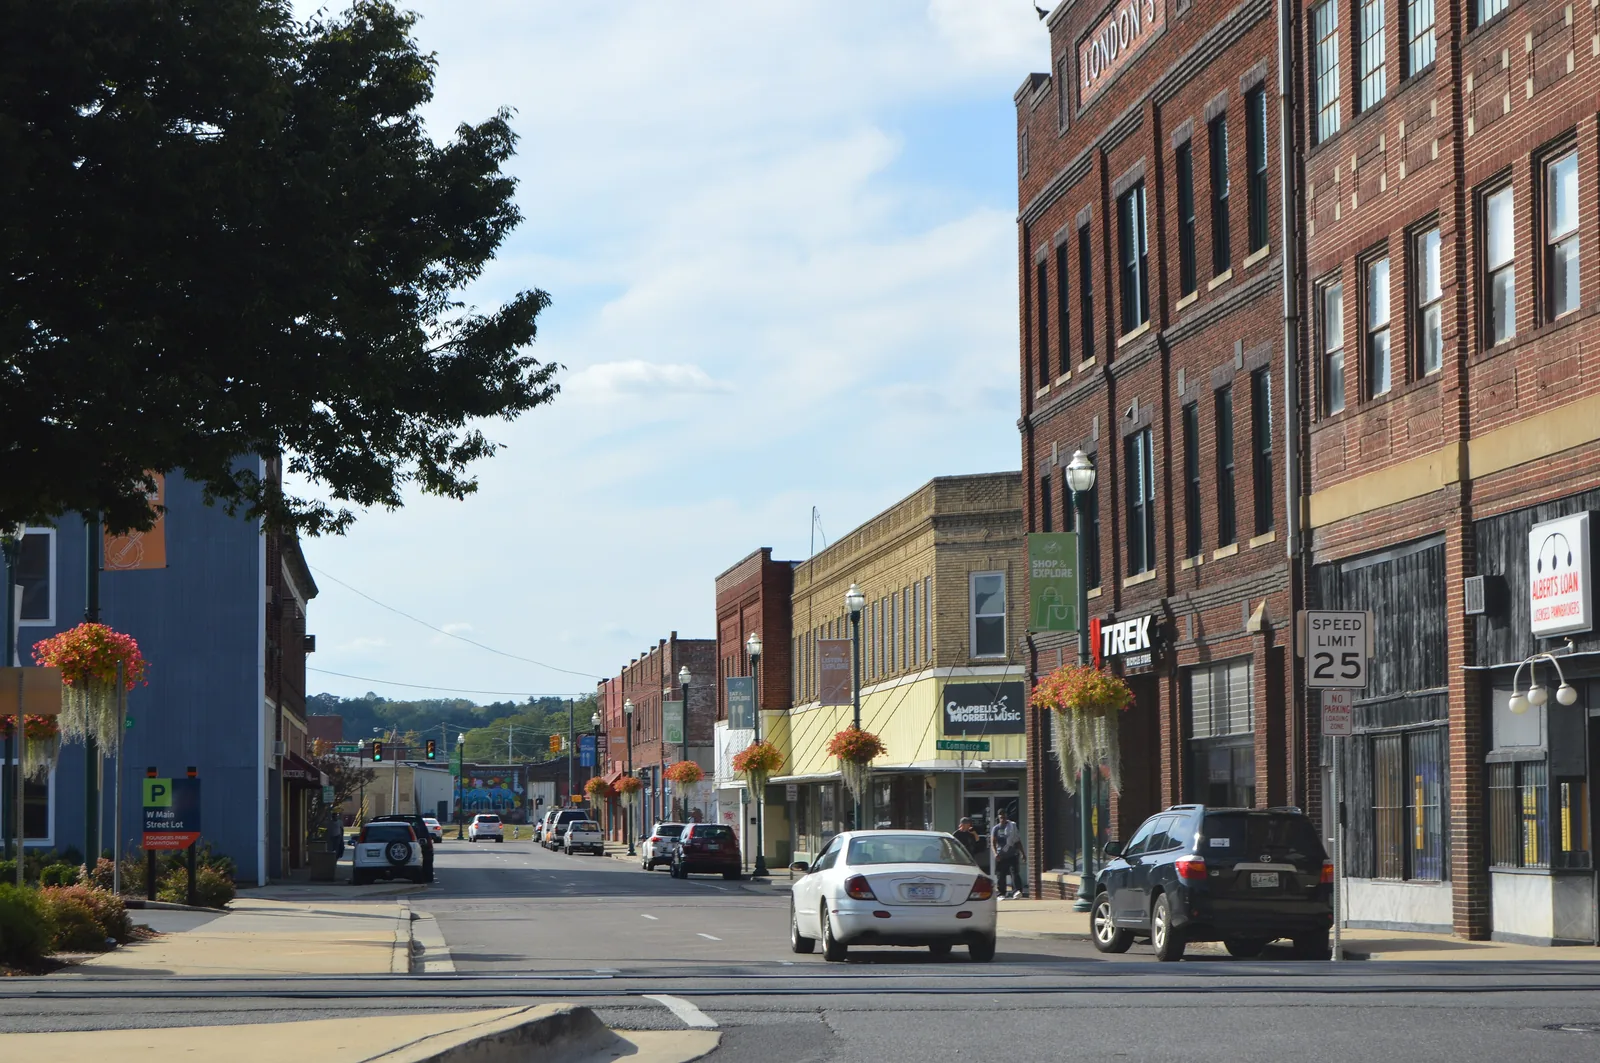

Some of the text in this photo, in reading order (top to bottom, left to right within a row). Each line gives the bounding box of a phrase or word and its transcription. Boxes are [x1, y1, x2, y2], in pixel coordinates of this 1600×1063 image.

[1032, 559, 1067, 568] SHOP &
[1032, 568, 1073, 578] EXPLORE
[1560, 570, 1579, 595] LOAN
[1312, 618, 1362, 631] SPEED
[1101, 615, 1152, 657] TREK
[1317, 635, 1356, 647] LIMIT
[1313, 652, 1361, 679] 25
[1331, 694, 1343, 704] NO
[1324, 704, 1350, 714] PARKING
[950, 713, 994, 722] MORRELL
[946, 742, 981, 751] Commerce
[151, 784, 166, 803] P
